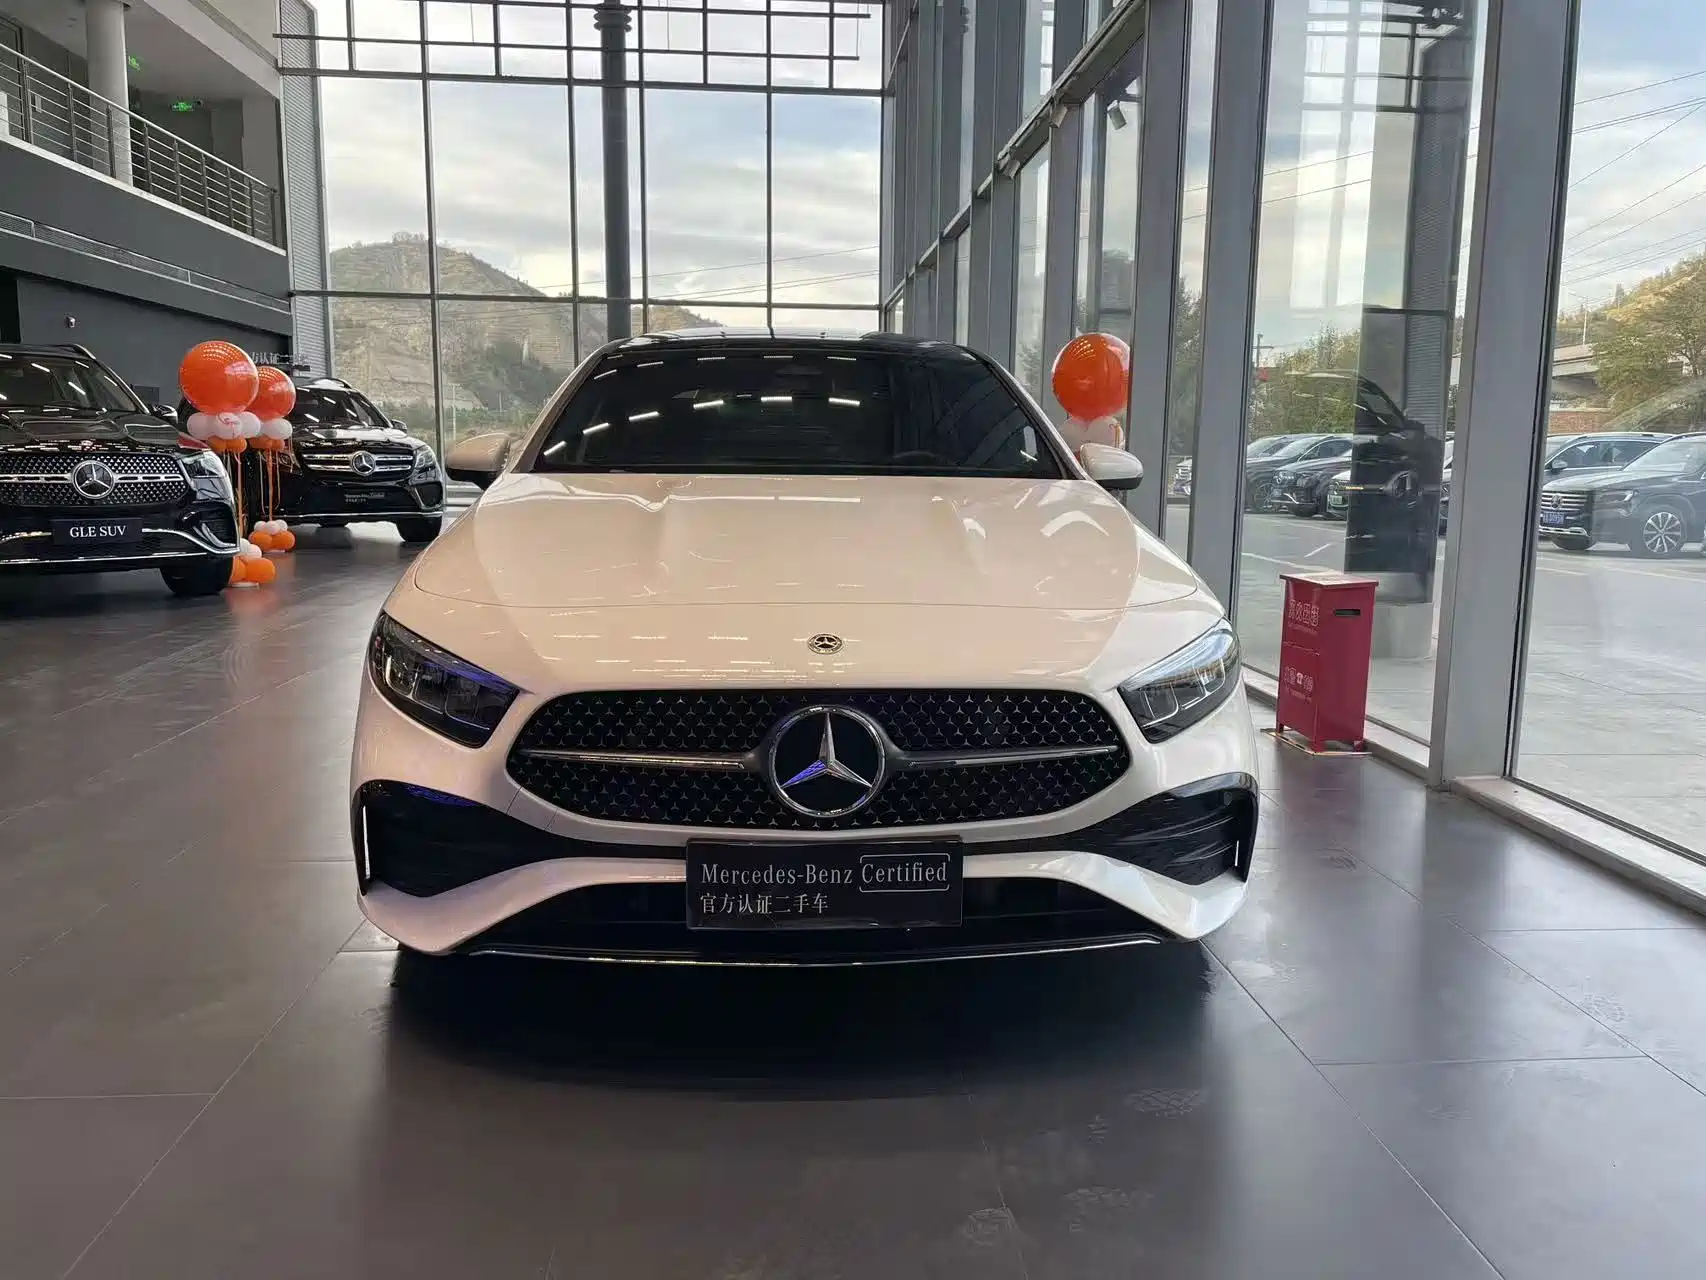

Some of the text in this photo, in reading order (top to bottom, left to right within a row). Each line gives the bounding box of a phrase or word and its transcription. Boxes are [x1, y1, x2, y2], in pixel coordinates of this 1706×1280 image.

[69, 525, 127, 538] GLE SUV
[701, 862, 947, 885] Mercedes-Benz Certified
[700, 893, 829, 914] 官方认证二手车
